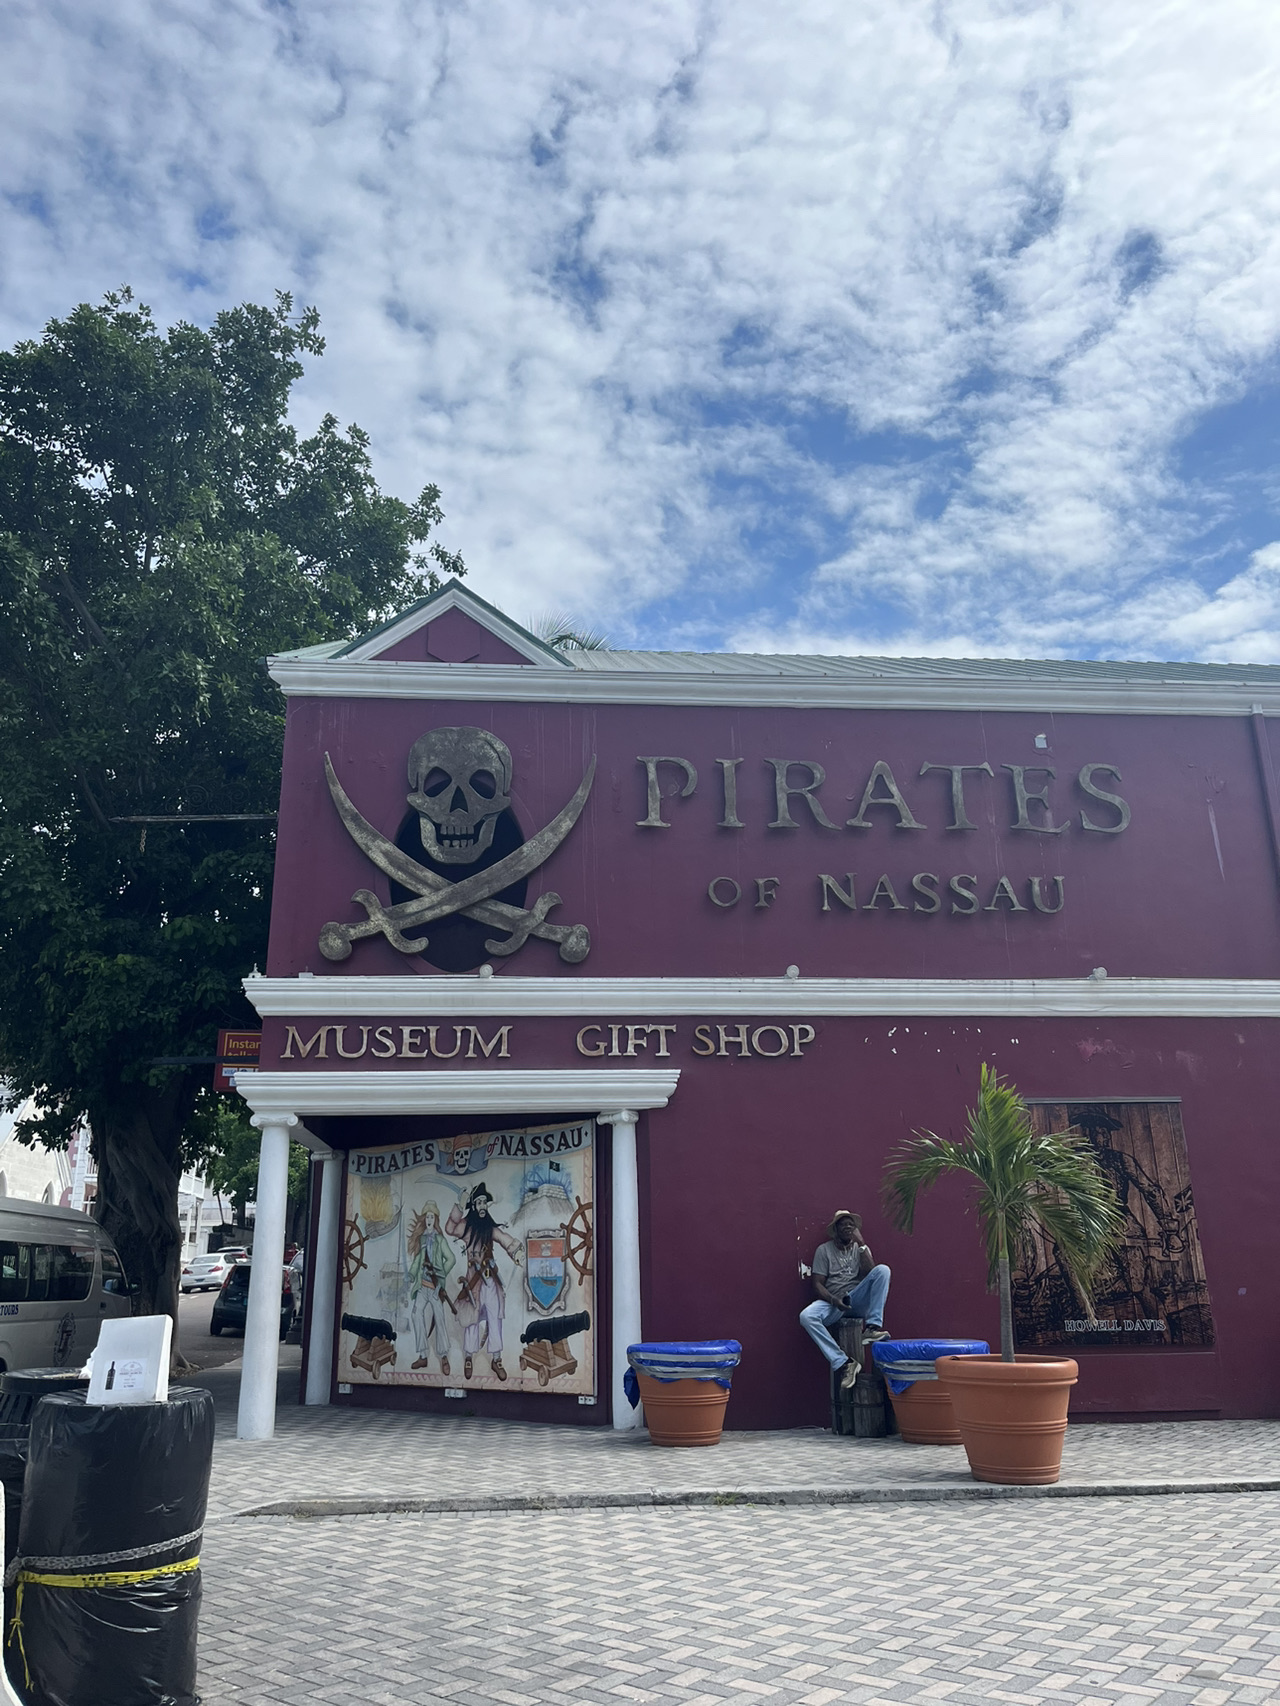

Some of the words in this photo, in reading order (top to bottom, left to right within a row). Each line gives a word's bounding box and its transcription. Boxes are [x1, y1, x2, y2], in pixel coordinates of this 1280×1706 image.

[635, 755, 1132, 834] PIRATES
[706, 876, 781, 908] OF
[817, 872, 1066, 915] NASSAU
[280, 1024, 513, 1059] MUSEUM
[576, 1023, 677, 1057] GIFT
[692, 1023, 816, 1057] SHOP
[355, 1142, 435, 1174] PIRATES
[487, 1136, 499, 1157] of
[498, 1126, 584, 1157] NASSAU
[1064, 1319, 1121, 1332] HOWELL
[1124, 1319, 1166, 1332] DAVIS
